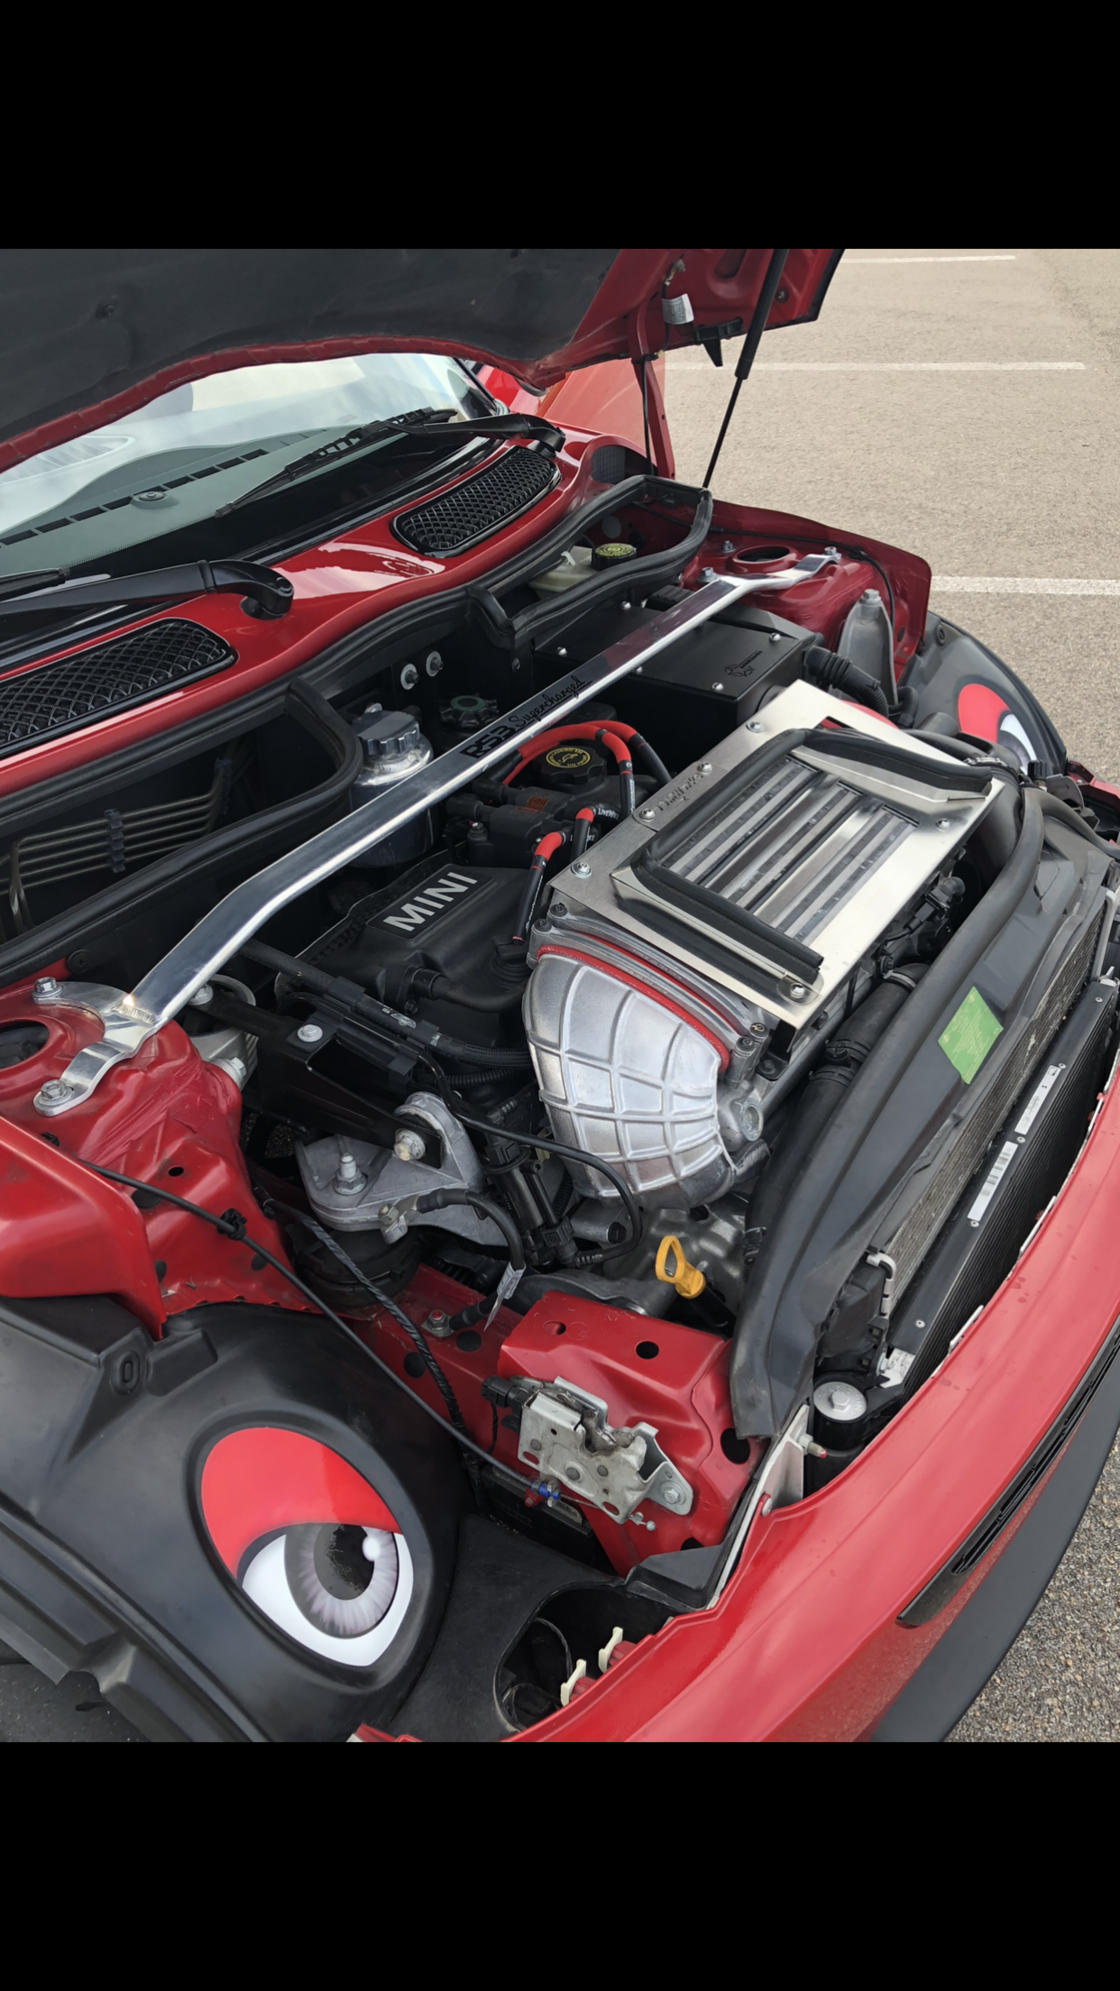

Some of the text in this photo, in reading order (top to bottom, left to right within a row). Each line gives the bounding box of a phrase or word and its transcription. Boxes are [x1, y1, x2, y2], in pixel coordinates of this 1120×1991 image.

[459, 725, 517, 759] R53
[508, 675, 588, 728] Supercharged
[383, 872, 478, 932] MINI
